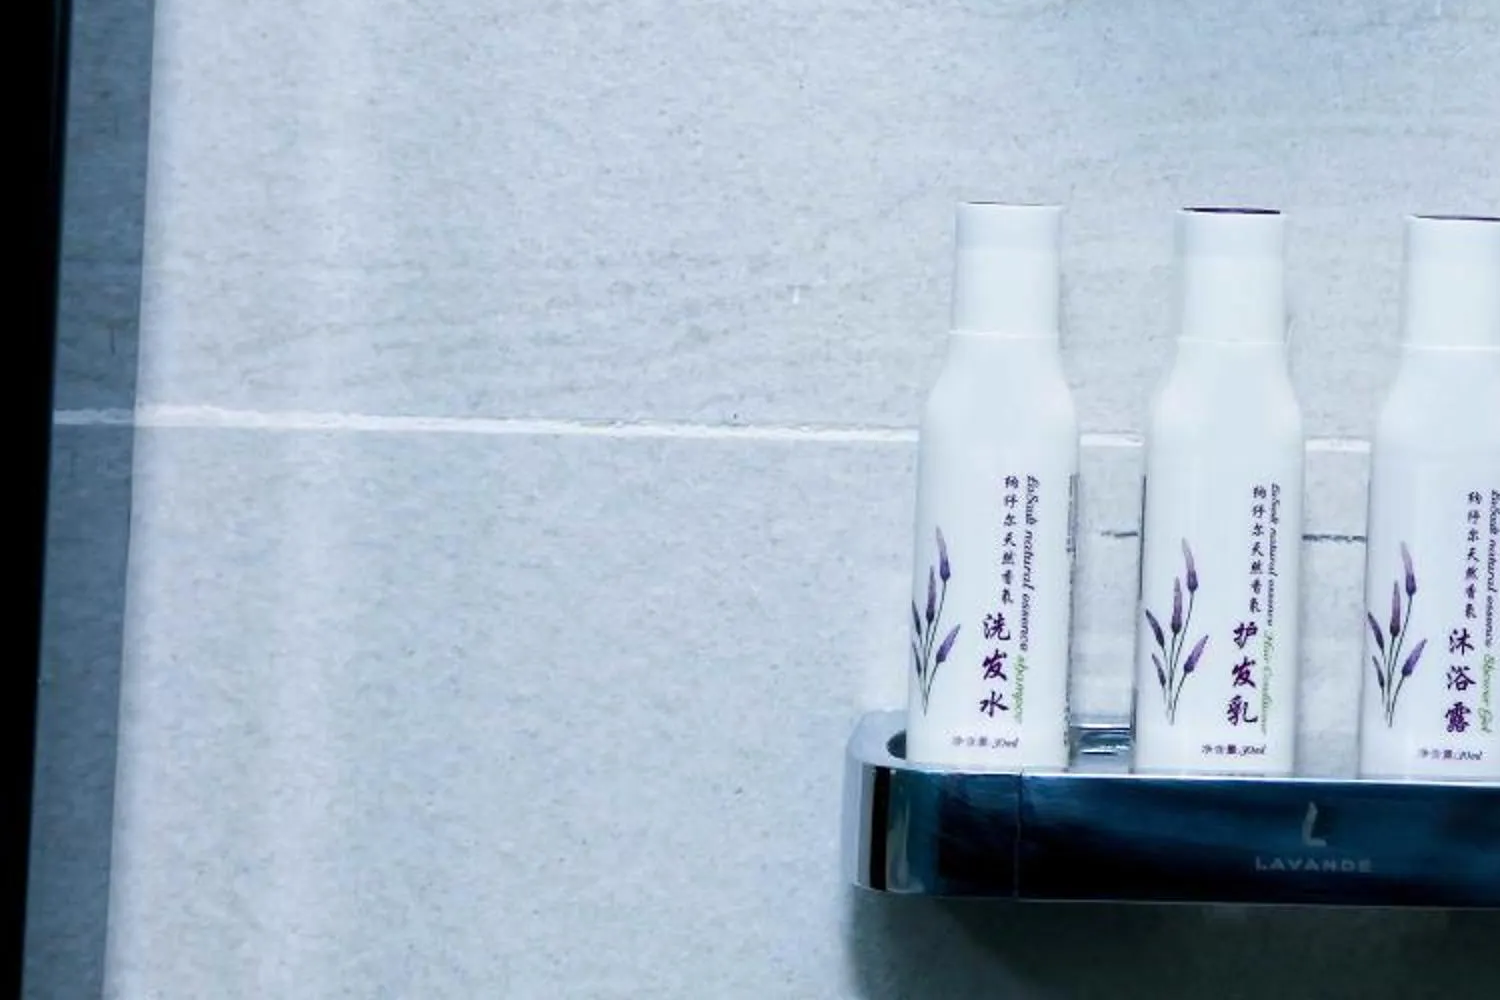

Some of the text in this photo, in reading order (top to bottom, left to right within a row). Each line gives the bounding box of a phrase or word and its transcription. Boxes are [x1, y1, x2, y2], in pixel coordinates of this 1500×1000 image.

[1023, 530, 1036, 590] natural
[1268, 527, 1279, 577] natural
[1487, 539, 1498, 593] natural
[1020, 593, 1031, 651] essence
[1485, 595, 1494, 647] essence
[980, 612, 1011, 718] 洗发水
[1227, 621, 1258, 726] 护发乳
[1444, 627, 1476, 733] 沐浴露
[1255, 856, 1373, 873] LAVANDE
